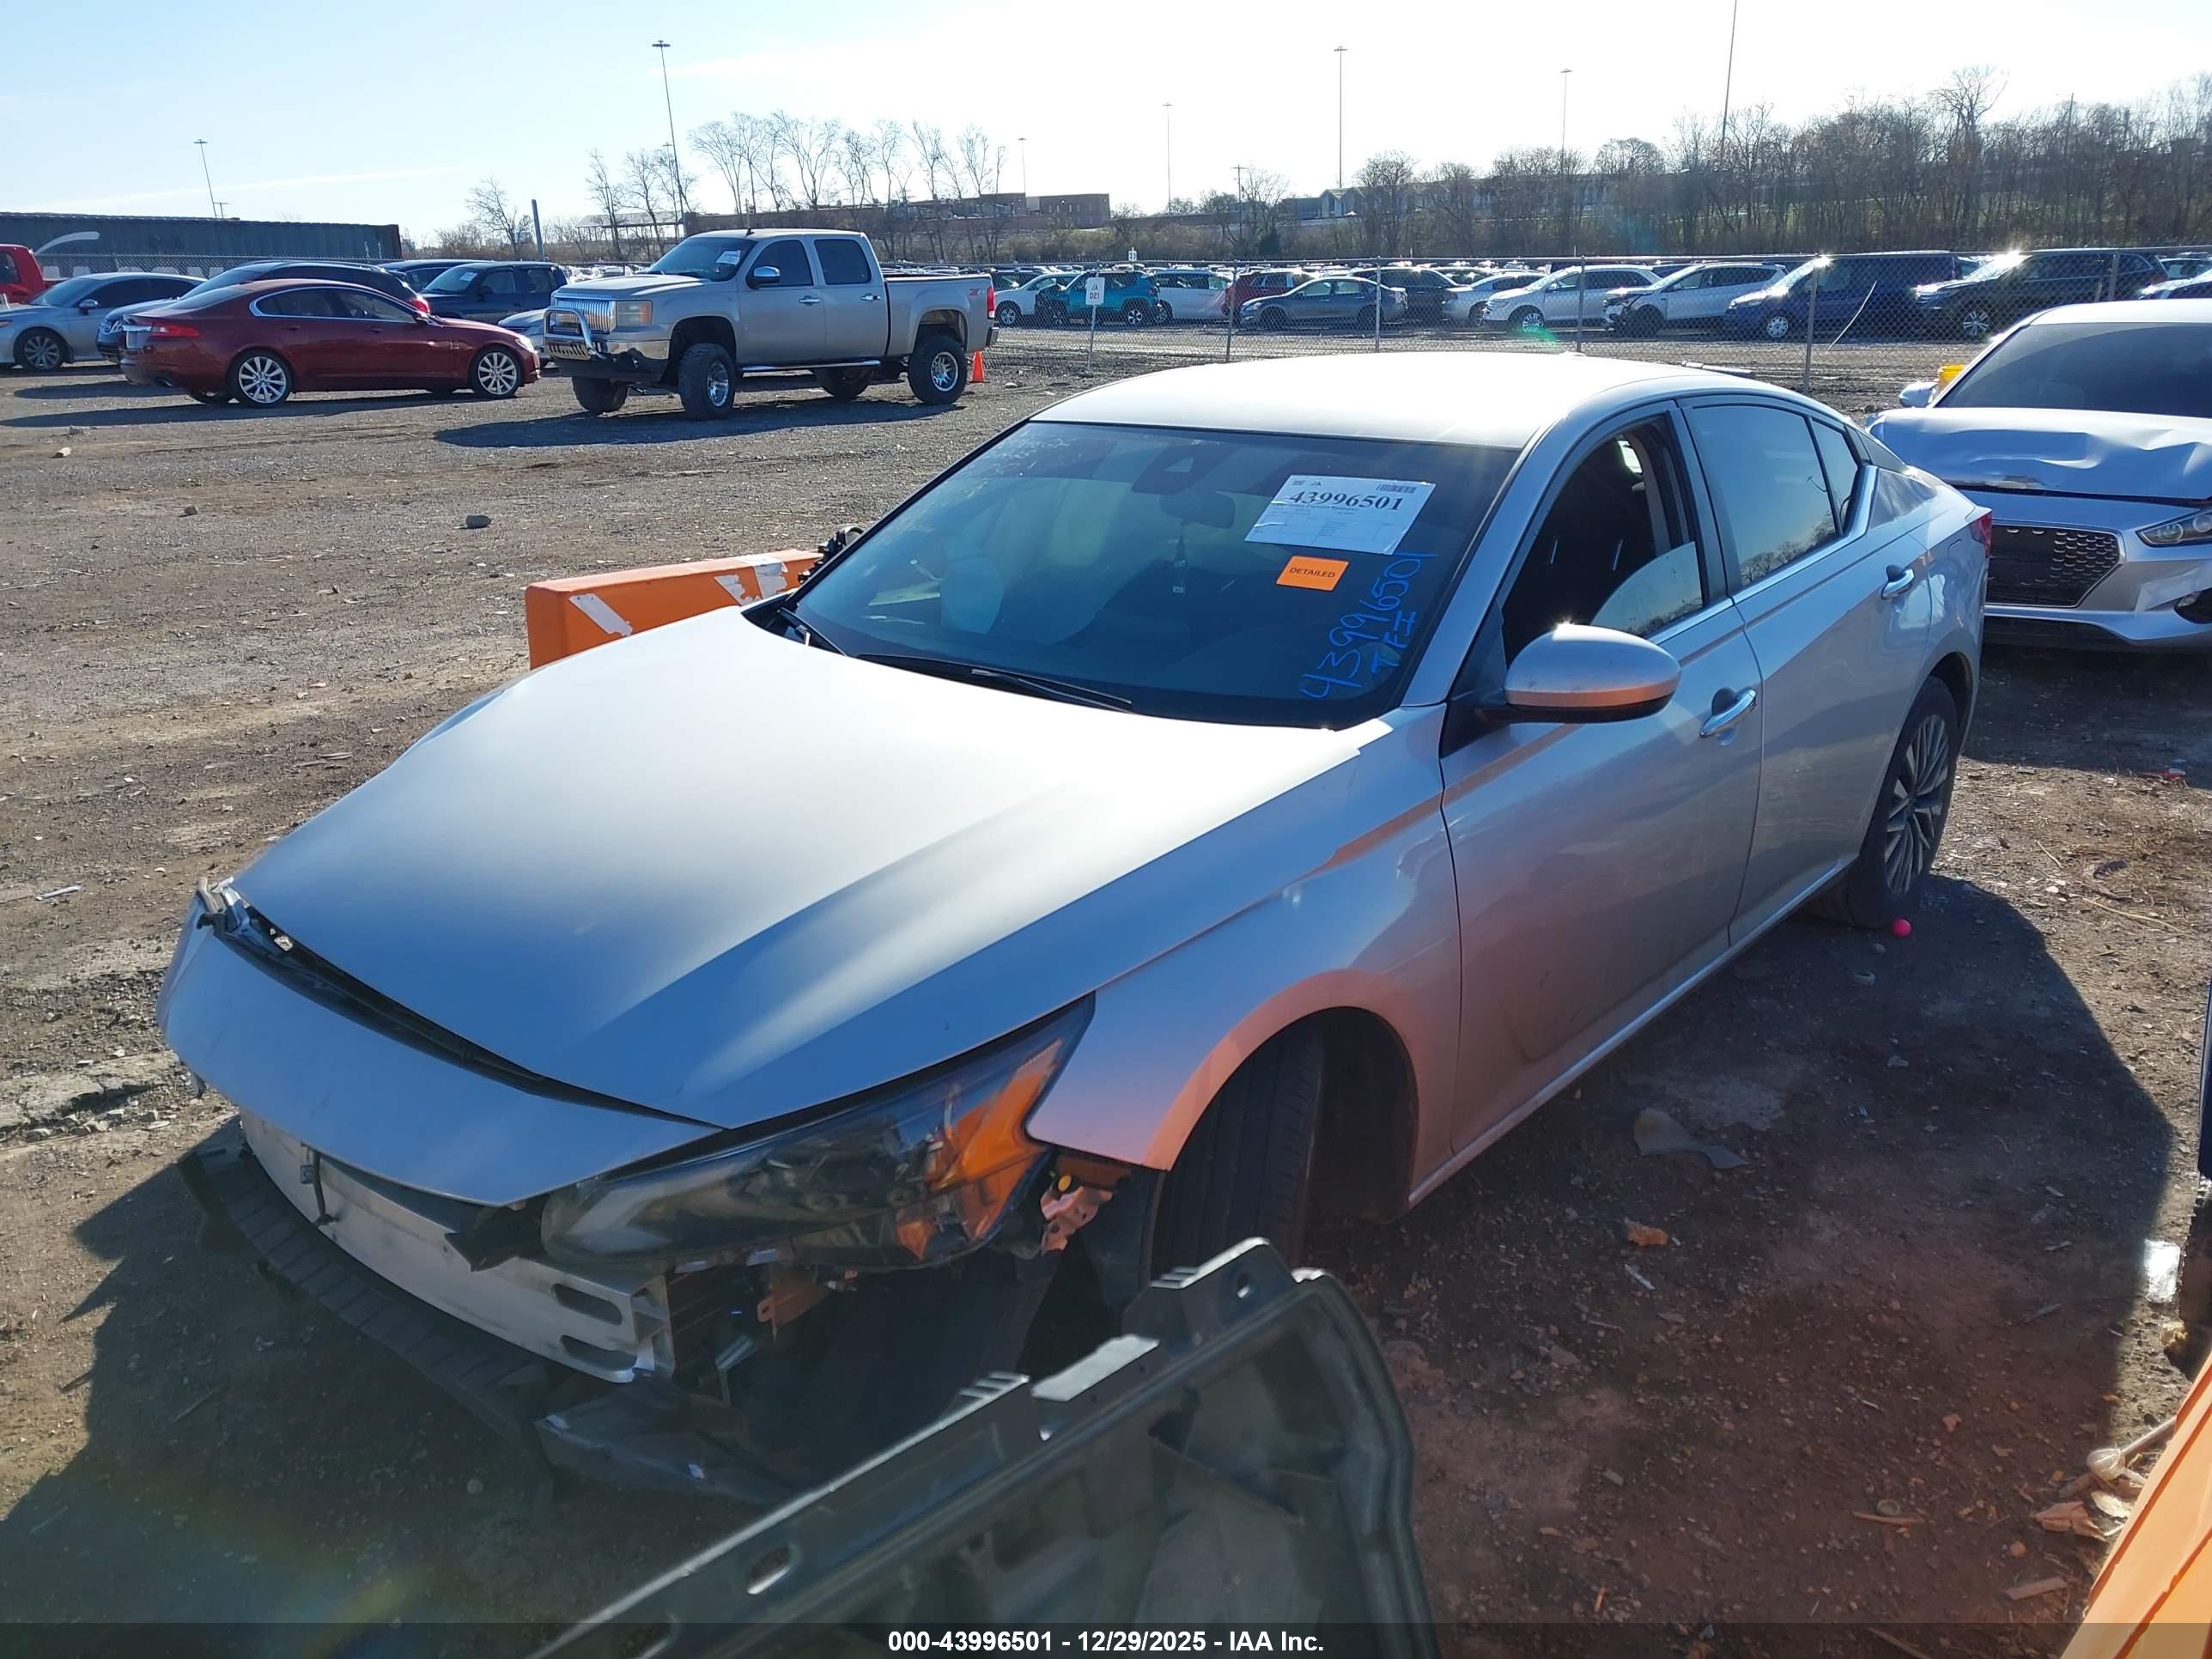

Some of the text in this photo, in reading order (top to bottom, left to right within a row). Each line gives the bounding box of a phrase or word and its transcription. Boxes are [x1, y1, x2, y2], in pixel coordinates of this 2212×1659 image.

[1289, 491, 1404, 510] 43996501
[1289, 567, 1335, 579] DETAILED
[1299, 552, 1438, 699] 43996501
